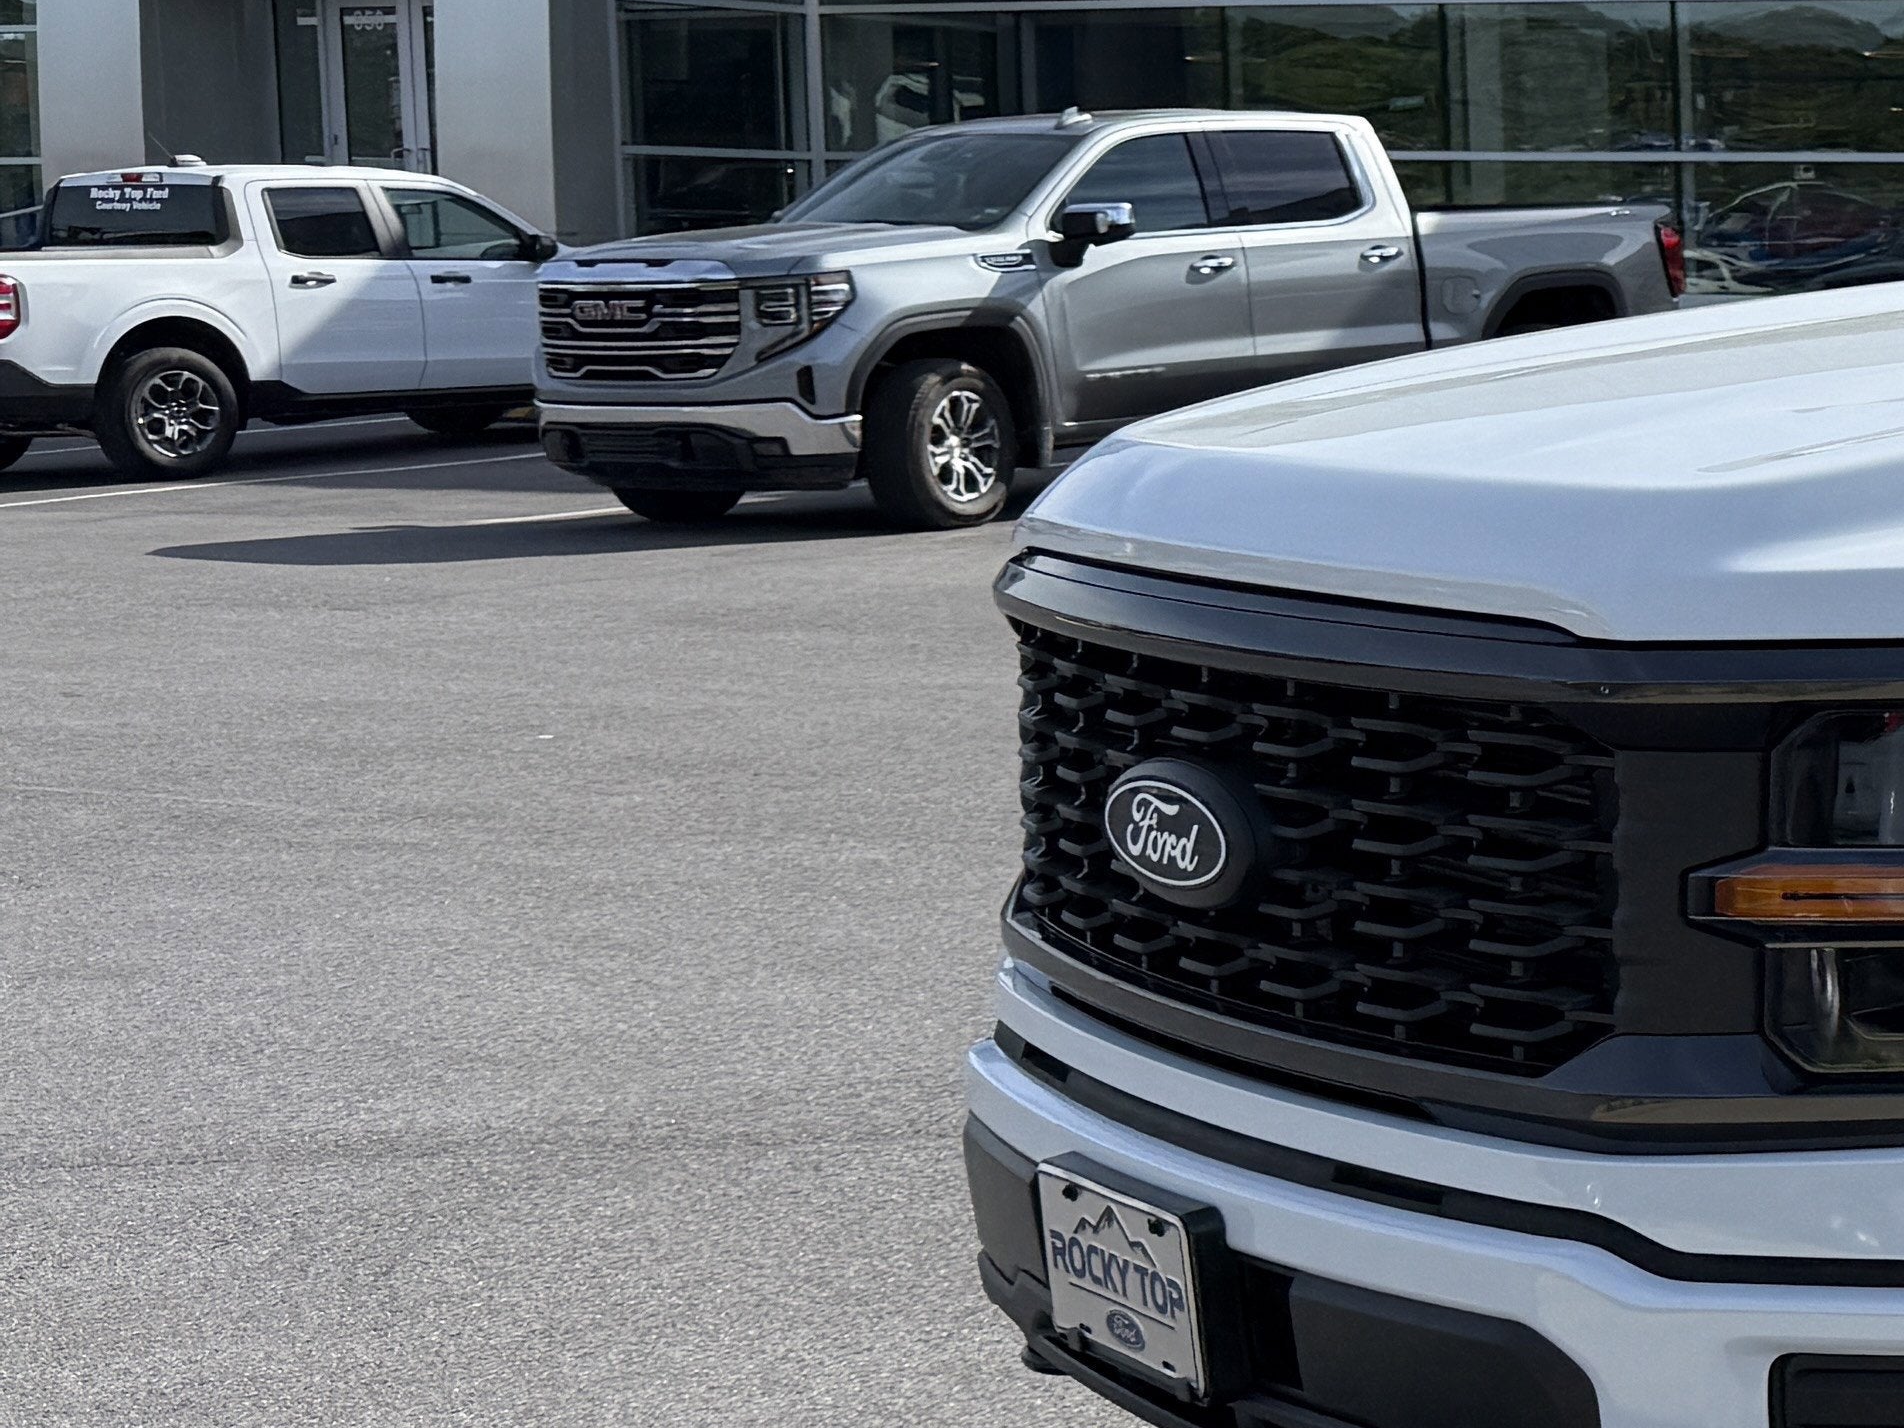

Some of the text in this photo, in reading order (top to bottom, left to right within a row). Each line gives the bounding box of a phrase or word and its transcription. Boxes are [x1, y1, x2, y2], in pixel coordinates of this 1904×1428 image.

[90, 187, 121, 200] Rocky
[124, 187, 144, 200] Top
[571, 300, 648, 320] GMC
[1126, 793, 1199, 872] Ford
[1049, 1228, 1185, 1321] ROCKY TOP
[1112, 1314, 1138, 1344] Ford
